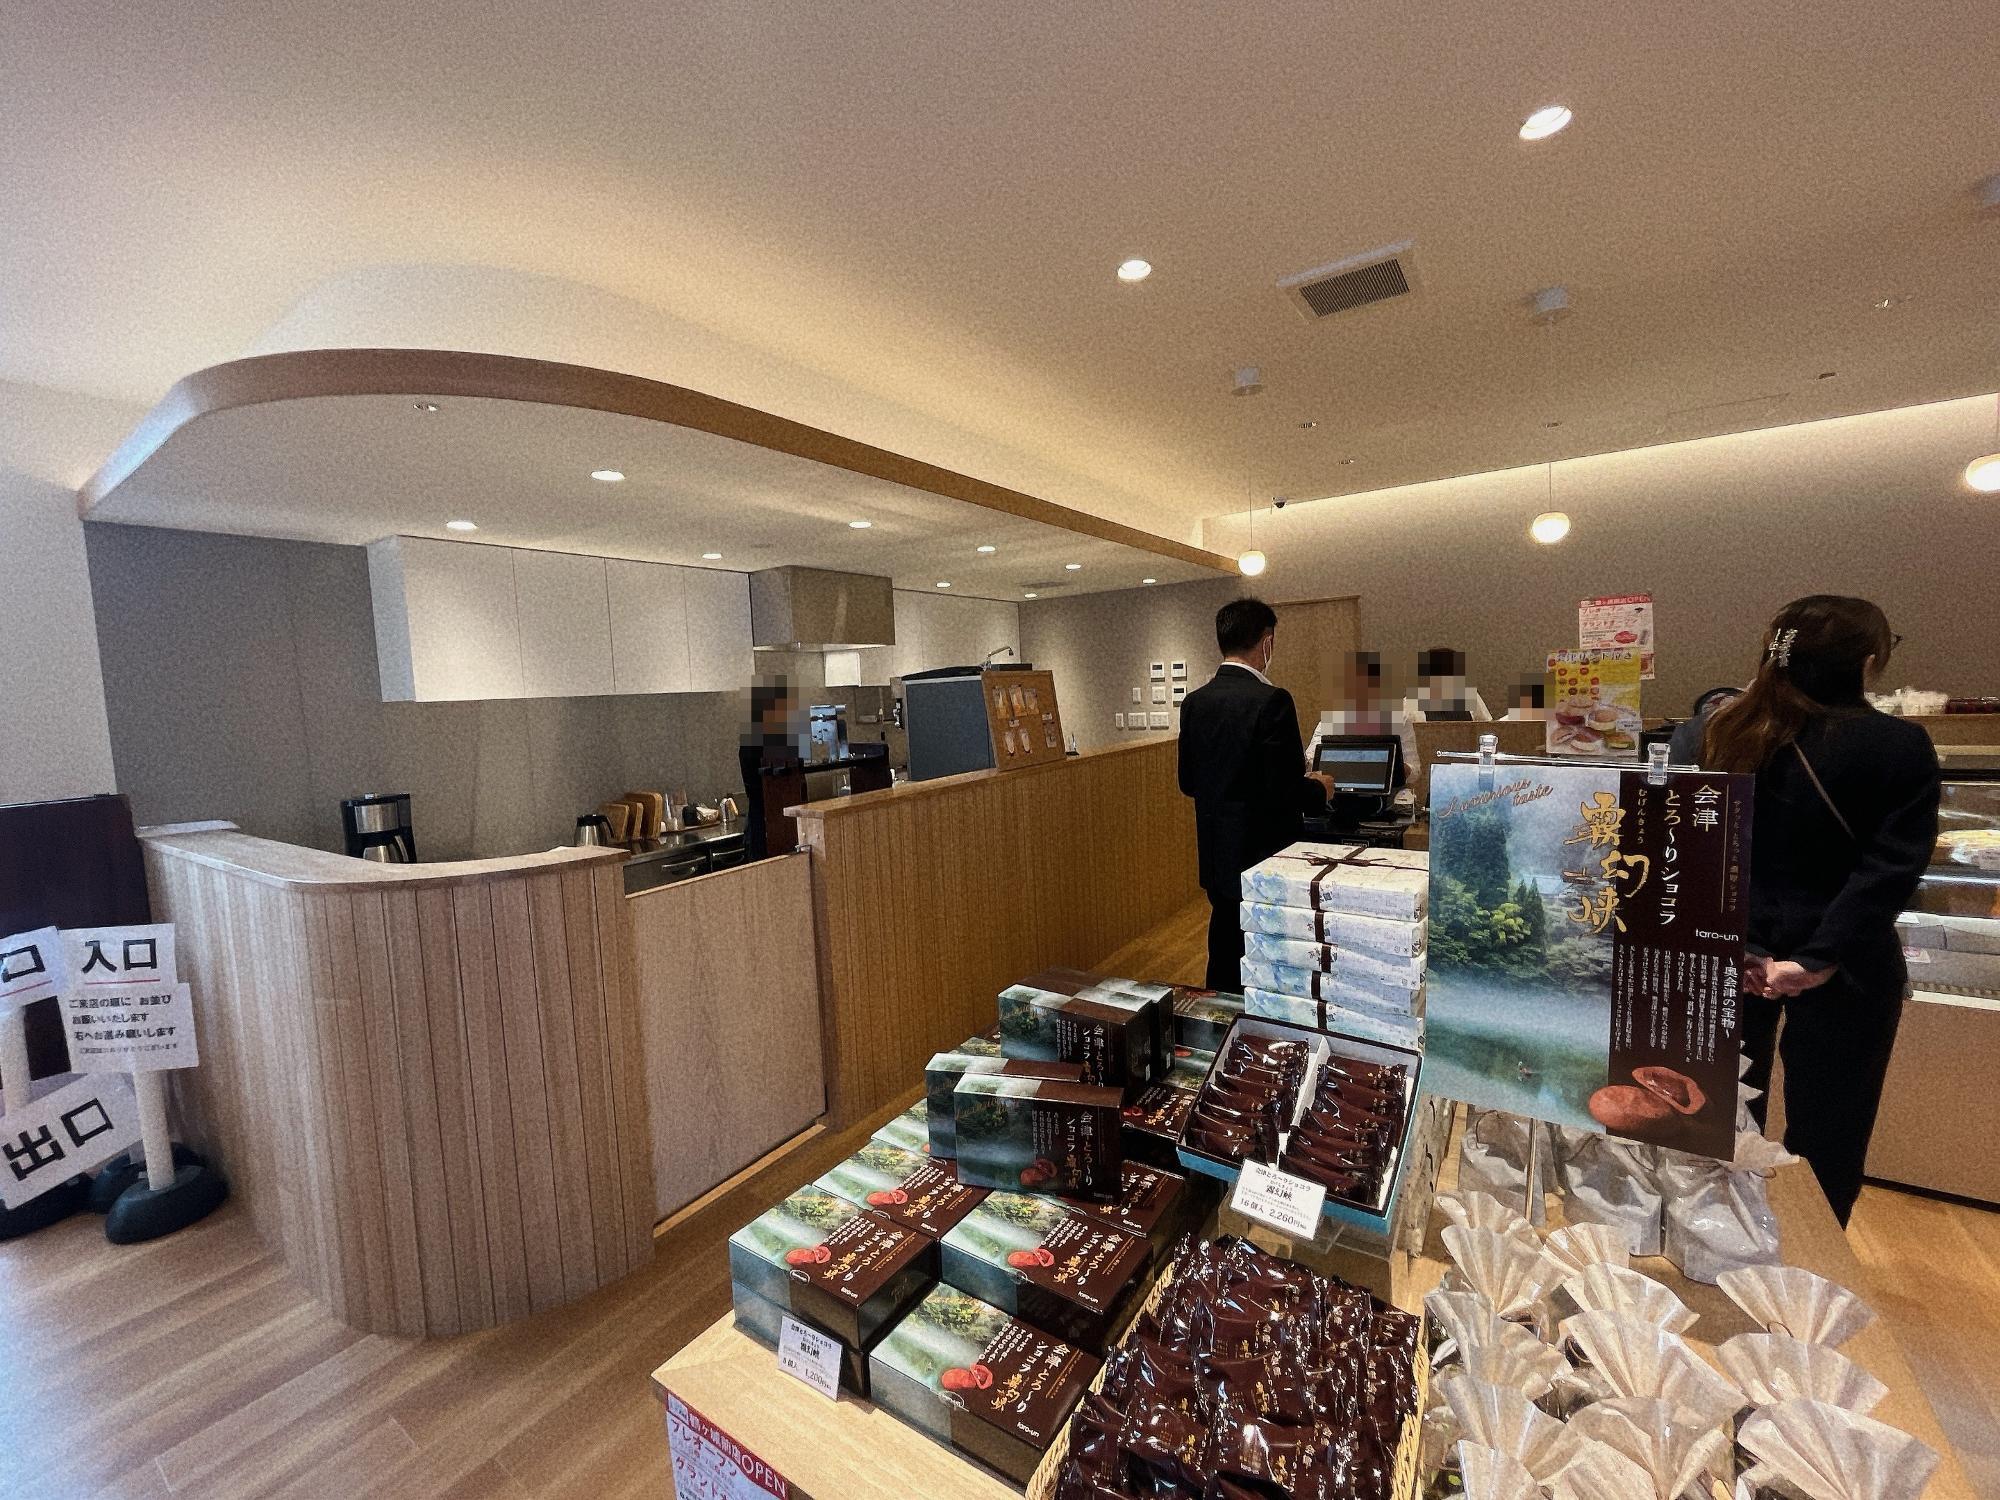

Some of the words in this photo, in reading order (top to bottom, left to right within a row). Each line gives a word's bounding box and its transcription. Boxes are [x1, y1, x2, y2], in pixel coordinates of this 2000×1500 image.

[1691, 784, 1722, 832] 会津
[82, 938, 157, 973] 入口
[1, 1098, 115, 1181] 出口
[987, 1325, 1019, 1364] CHOCOLAT
[1016, 1333, 1033, 1352] AIZU
[1019, 1340, 1049, 1373] ショコラ
